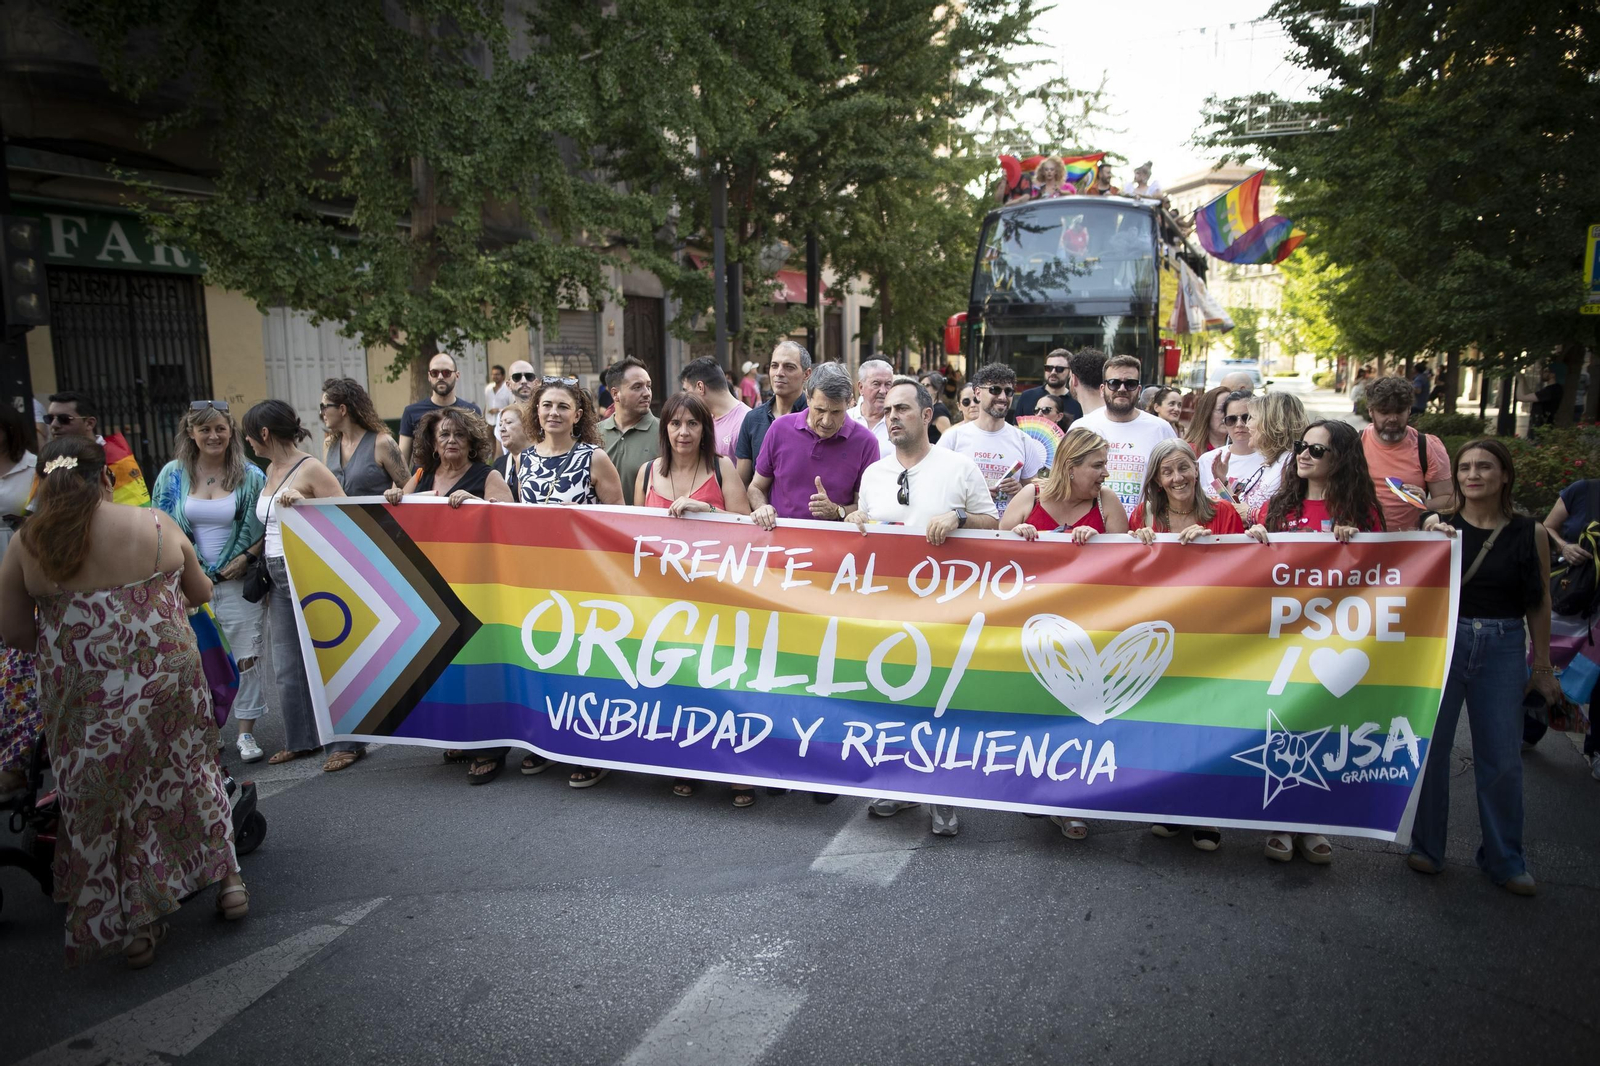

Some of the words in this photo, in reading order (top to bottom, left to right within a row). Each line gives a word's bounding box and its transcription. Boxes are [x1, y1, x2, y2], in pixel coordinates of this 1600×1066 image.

[44, 213, 208, 269] FAR
[1107, 455, 1145, 463] ULLOSOS
[1107, 463, 1144, 471] EFENDER
[633, 534, 813, 591] FRENTE
[830, 552, 889, 595] AL
[907, 556, 1036, 603] ODIO:
[1271, 563, 1401, 586] Granada
[1268, 596, 1407, 642] PSOE
[545, 692, 773, 754] VISIBILIDAD
[792, 717, 824, 758] Y
[841, 720, 1117, 785] RESILIENCIA
[1322, 716, 1421, 772] JSA
[1341, 765, 1409, 784] GRANADA
